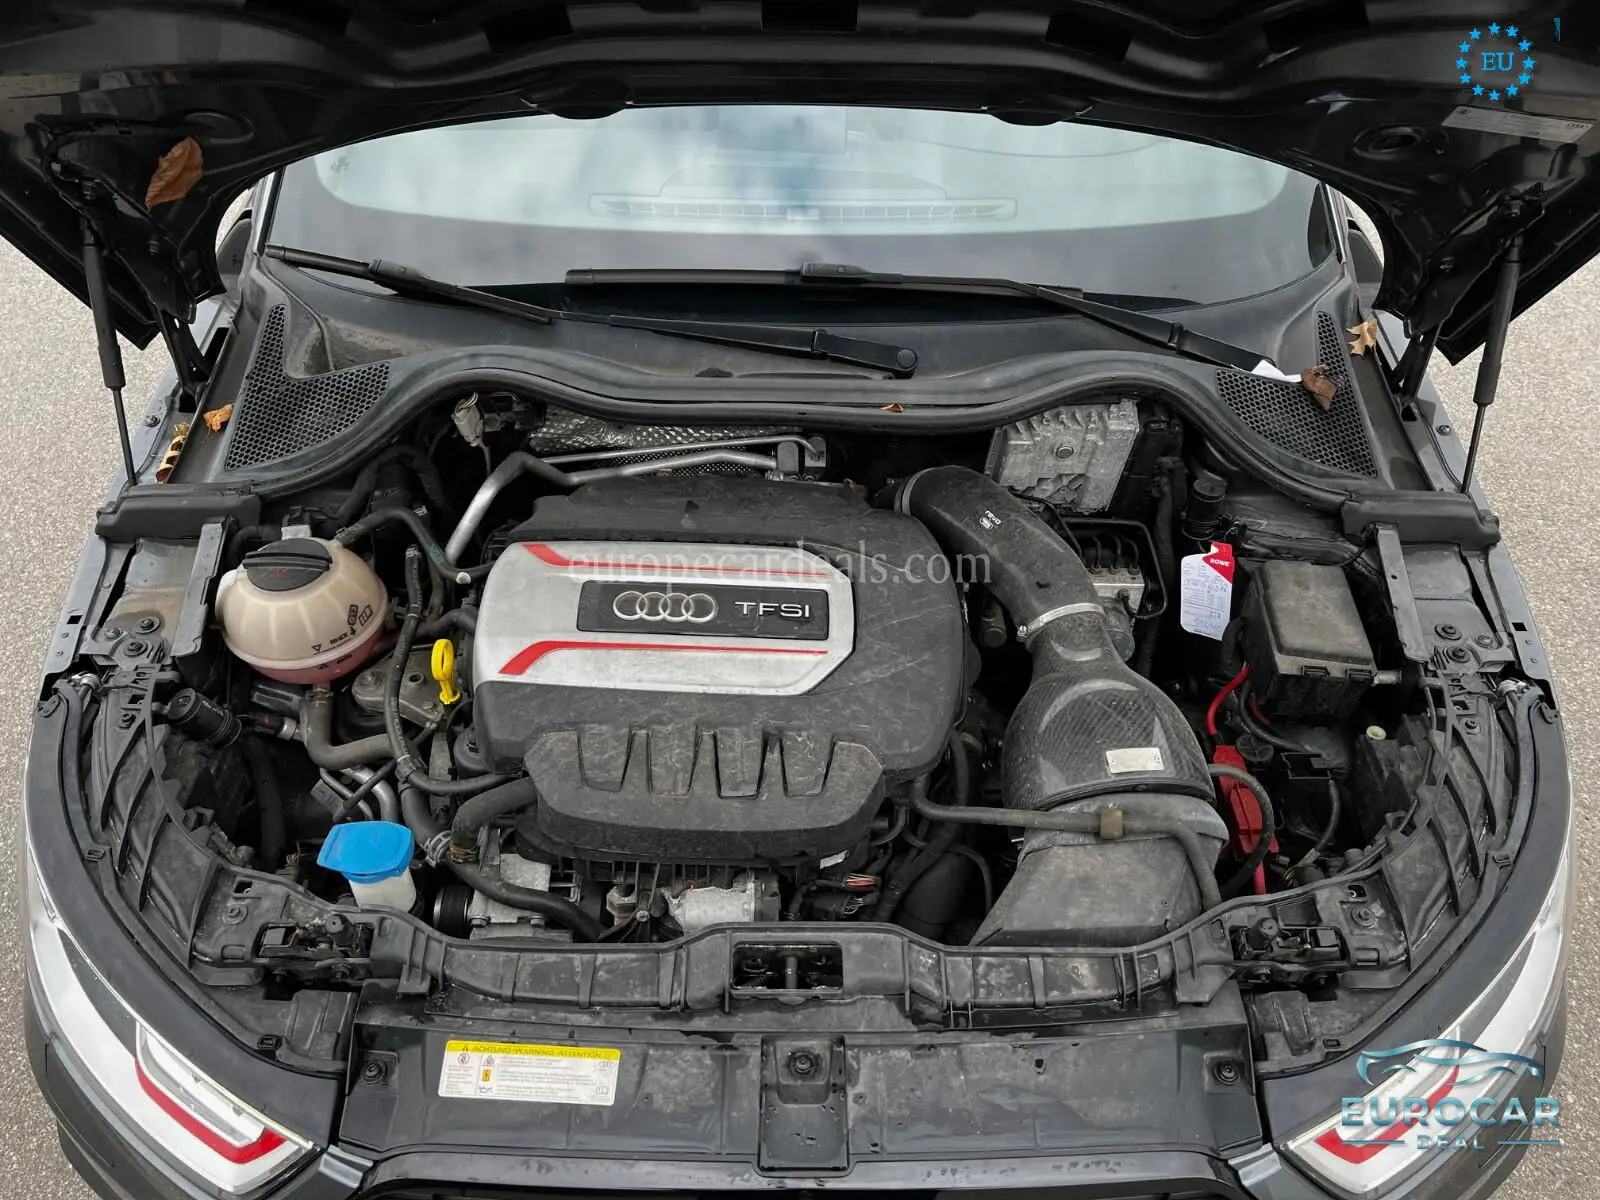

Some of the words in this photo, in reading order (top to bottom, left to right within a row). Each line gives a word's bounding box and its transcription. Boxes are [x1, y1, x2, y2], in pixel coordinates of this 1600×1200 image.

[1209, 557, 1230, 568] ROWE
[734, 601, 810, 618] TFSI
[515, 1048, 554, 1057] WARNING
[556, 1050, 602, 1059] ATTENTION
